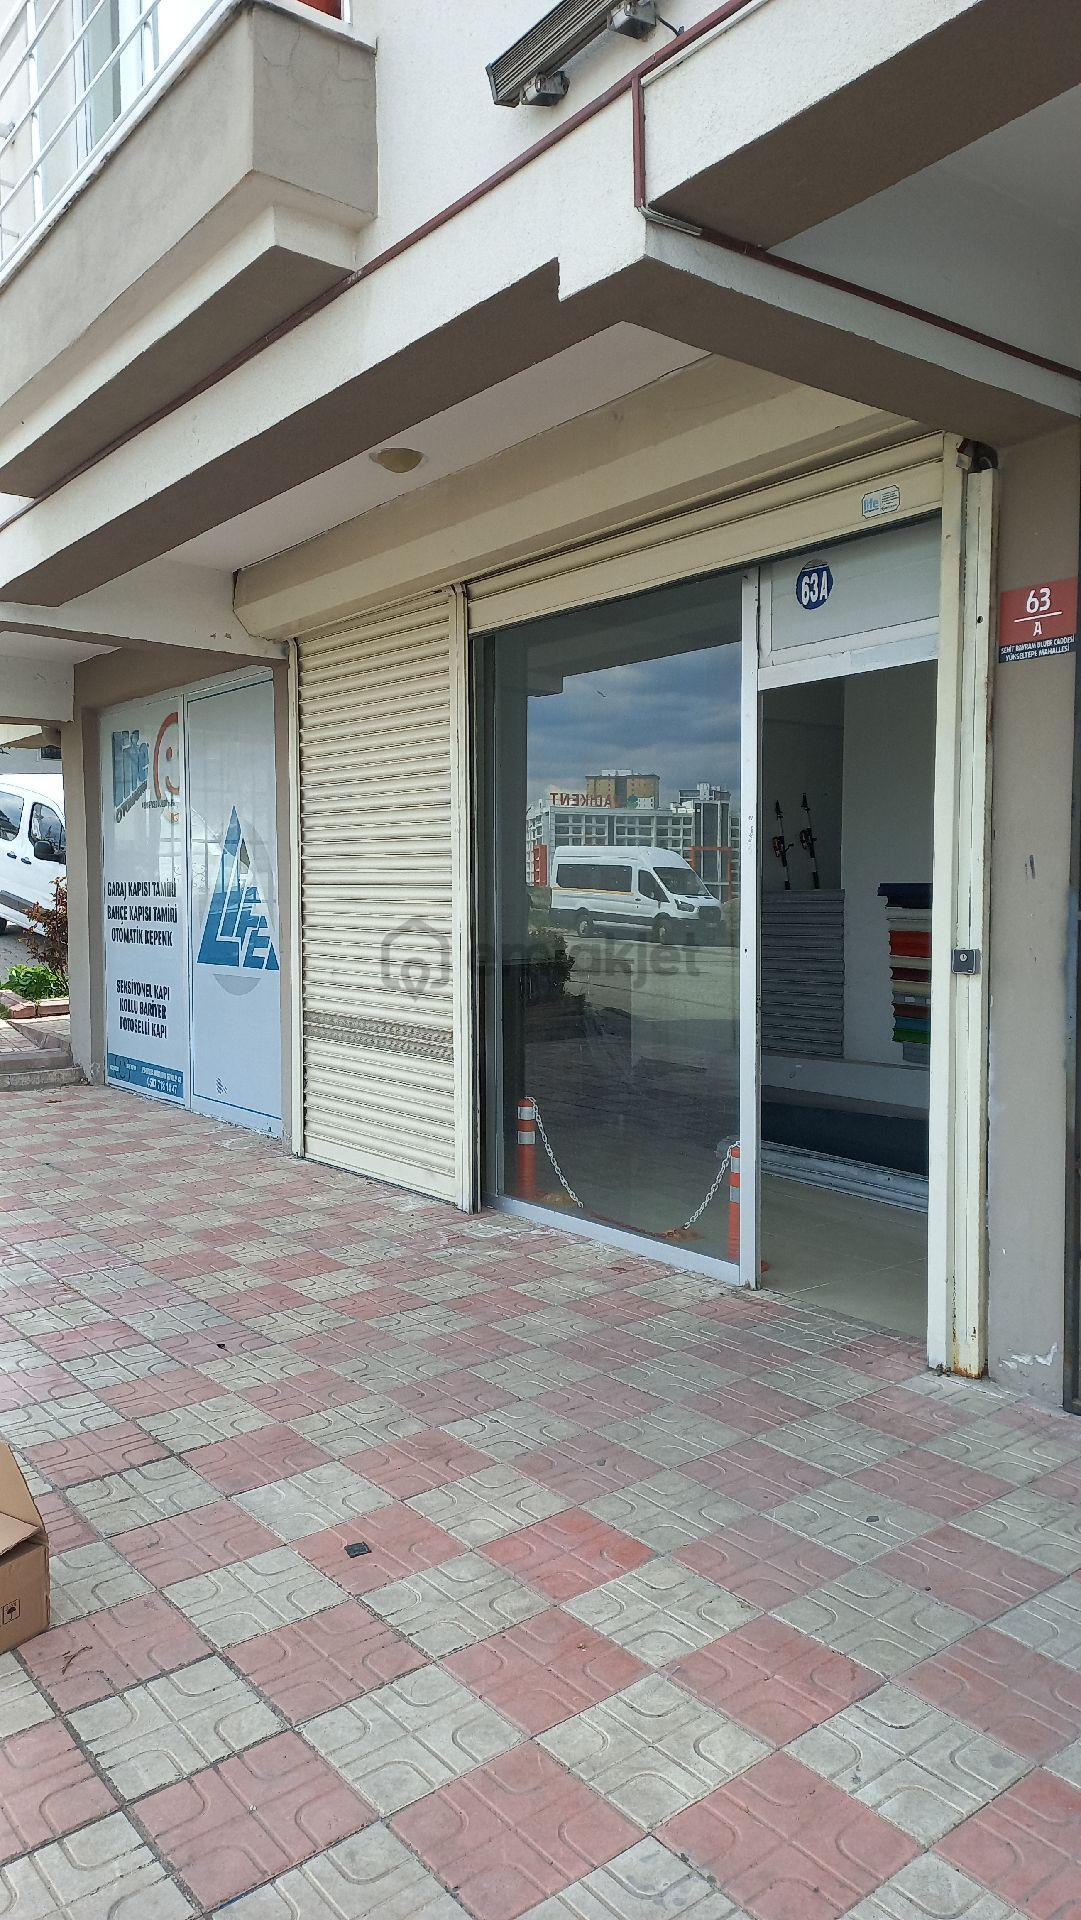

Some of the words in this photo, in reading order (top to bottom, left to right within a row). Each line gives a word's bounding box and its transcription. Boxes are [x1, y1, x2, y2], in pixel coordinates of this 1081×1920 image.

[801, 571, 828, 606] 63A
[1026, 587, 1051, 613] 63
[1032, 621, 1043, 636] A
[1005, 650, 1038, 661] YÜKSELTEPE
[1038, 644, 1070, 656] MAHALLESİ
[107, 882, 127, 900] GARAJ
[128, 882, 151, 896] KAPISI
[107, 905, 128, 924] BAHÇE
[129, 905, 152, 921] KAPISI
[153, 904, 178, 923] TAMİRİ
[112, 926, 144, 945] OTOMATİK
[144, 930, 173, 947] KEPENK
[153, 984, 170, 1000] KAPI
[119, 998, 138, 1014] KOLLU
[151, 1023, 167, 1039] KAPI
